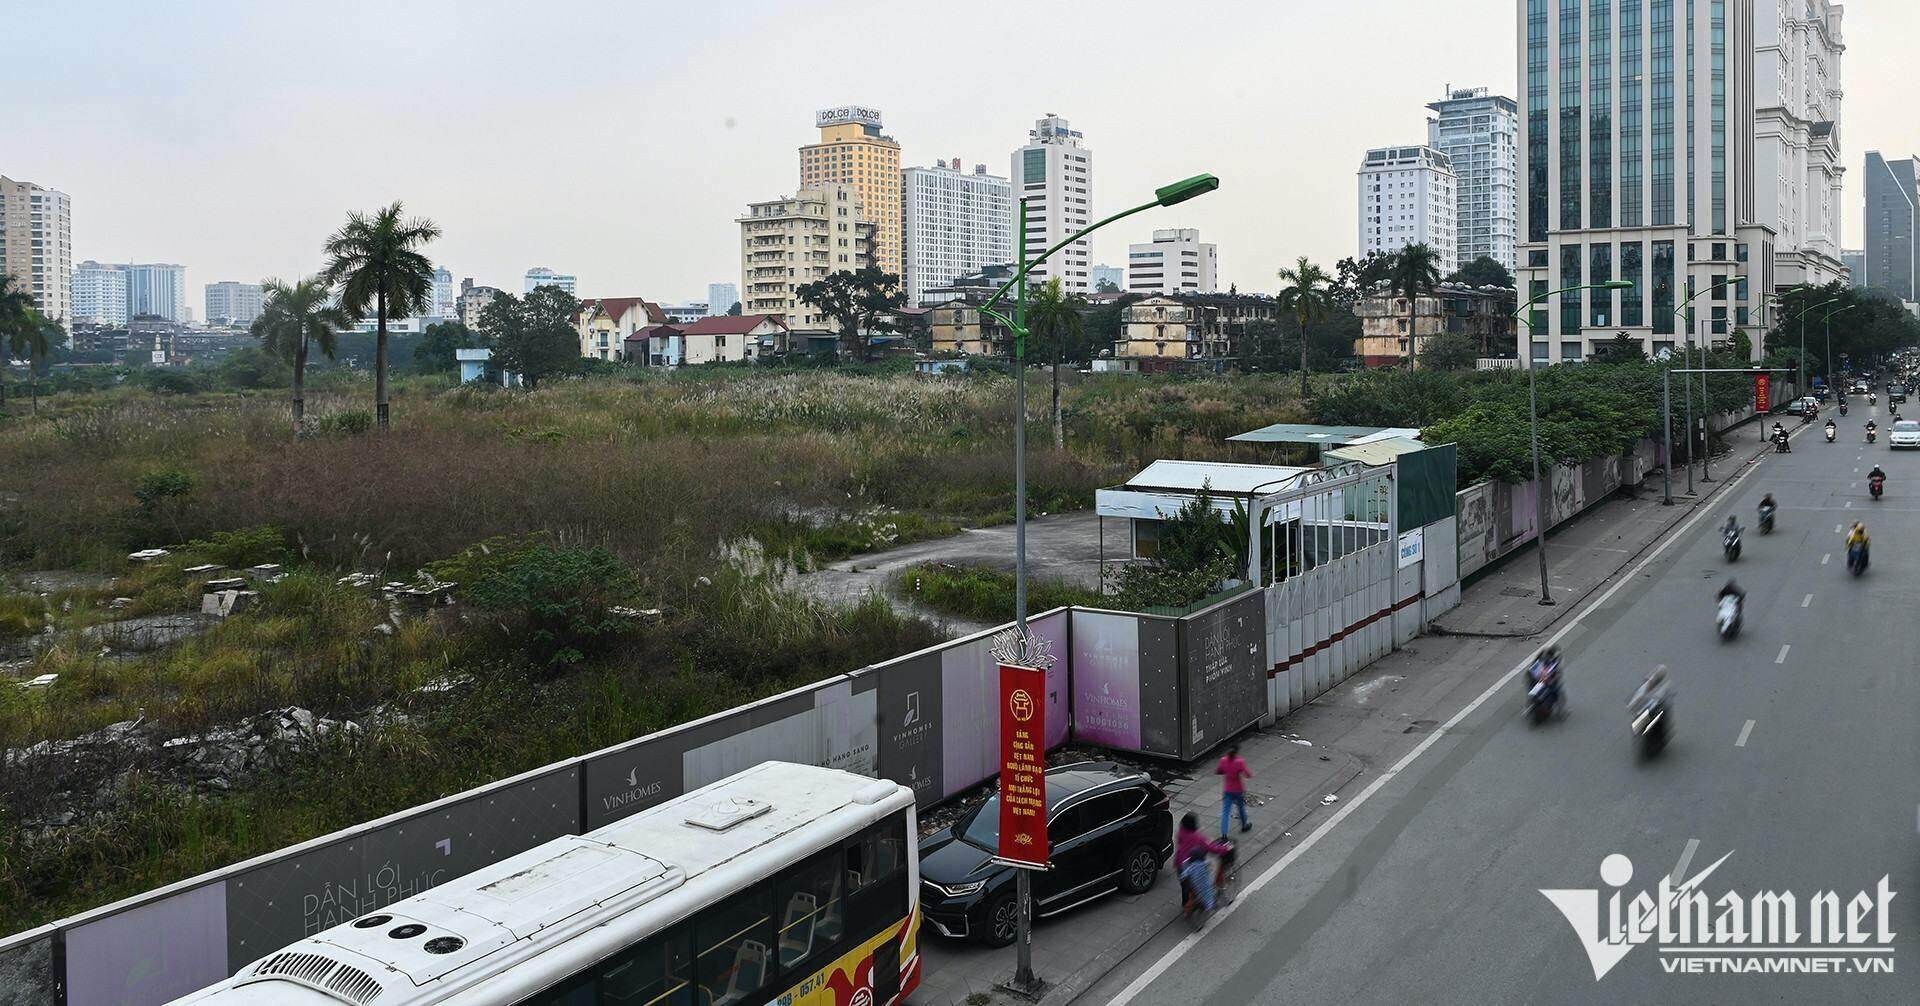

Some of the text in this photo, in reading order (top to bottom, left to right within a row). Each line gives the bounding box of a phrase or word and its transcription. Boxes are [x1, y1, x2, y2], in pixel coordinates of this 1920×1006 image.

[822, 108, 849, 120] DOLCE
[856, 108, 880, 120] DOLCE
[893, 722, 932, 742] VINHOMES
[603, 780, 661, 810] VINHOMES
[304, 860, 400, 917] DẪN LỐI
[388, 868, 446, 905] PHÚC
[800, 972, 824, 998] 057.41
